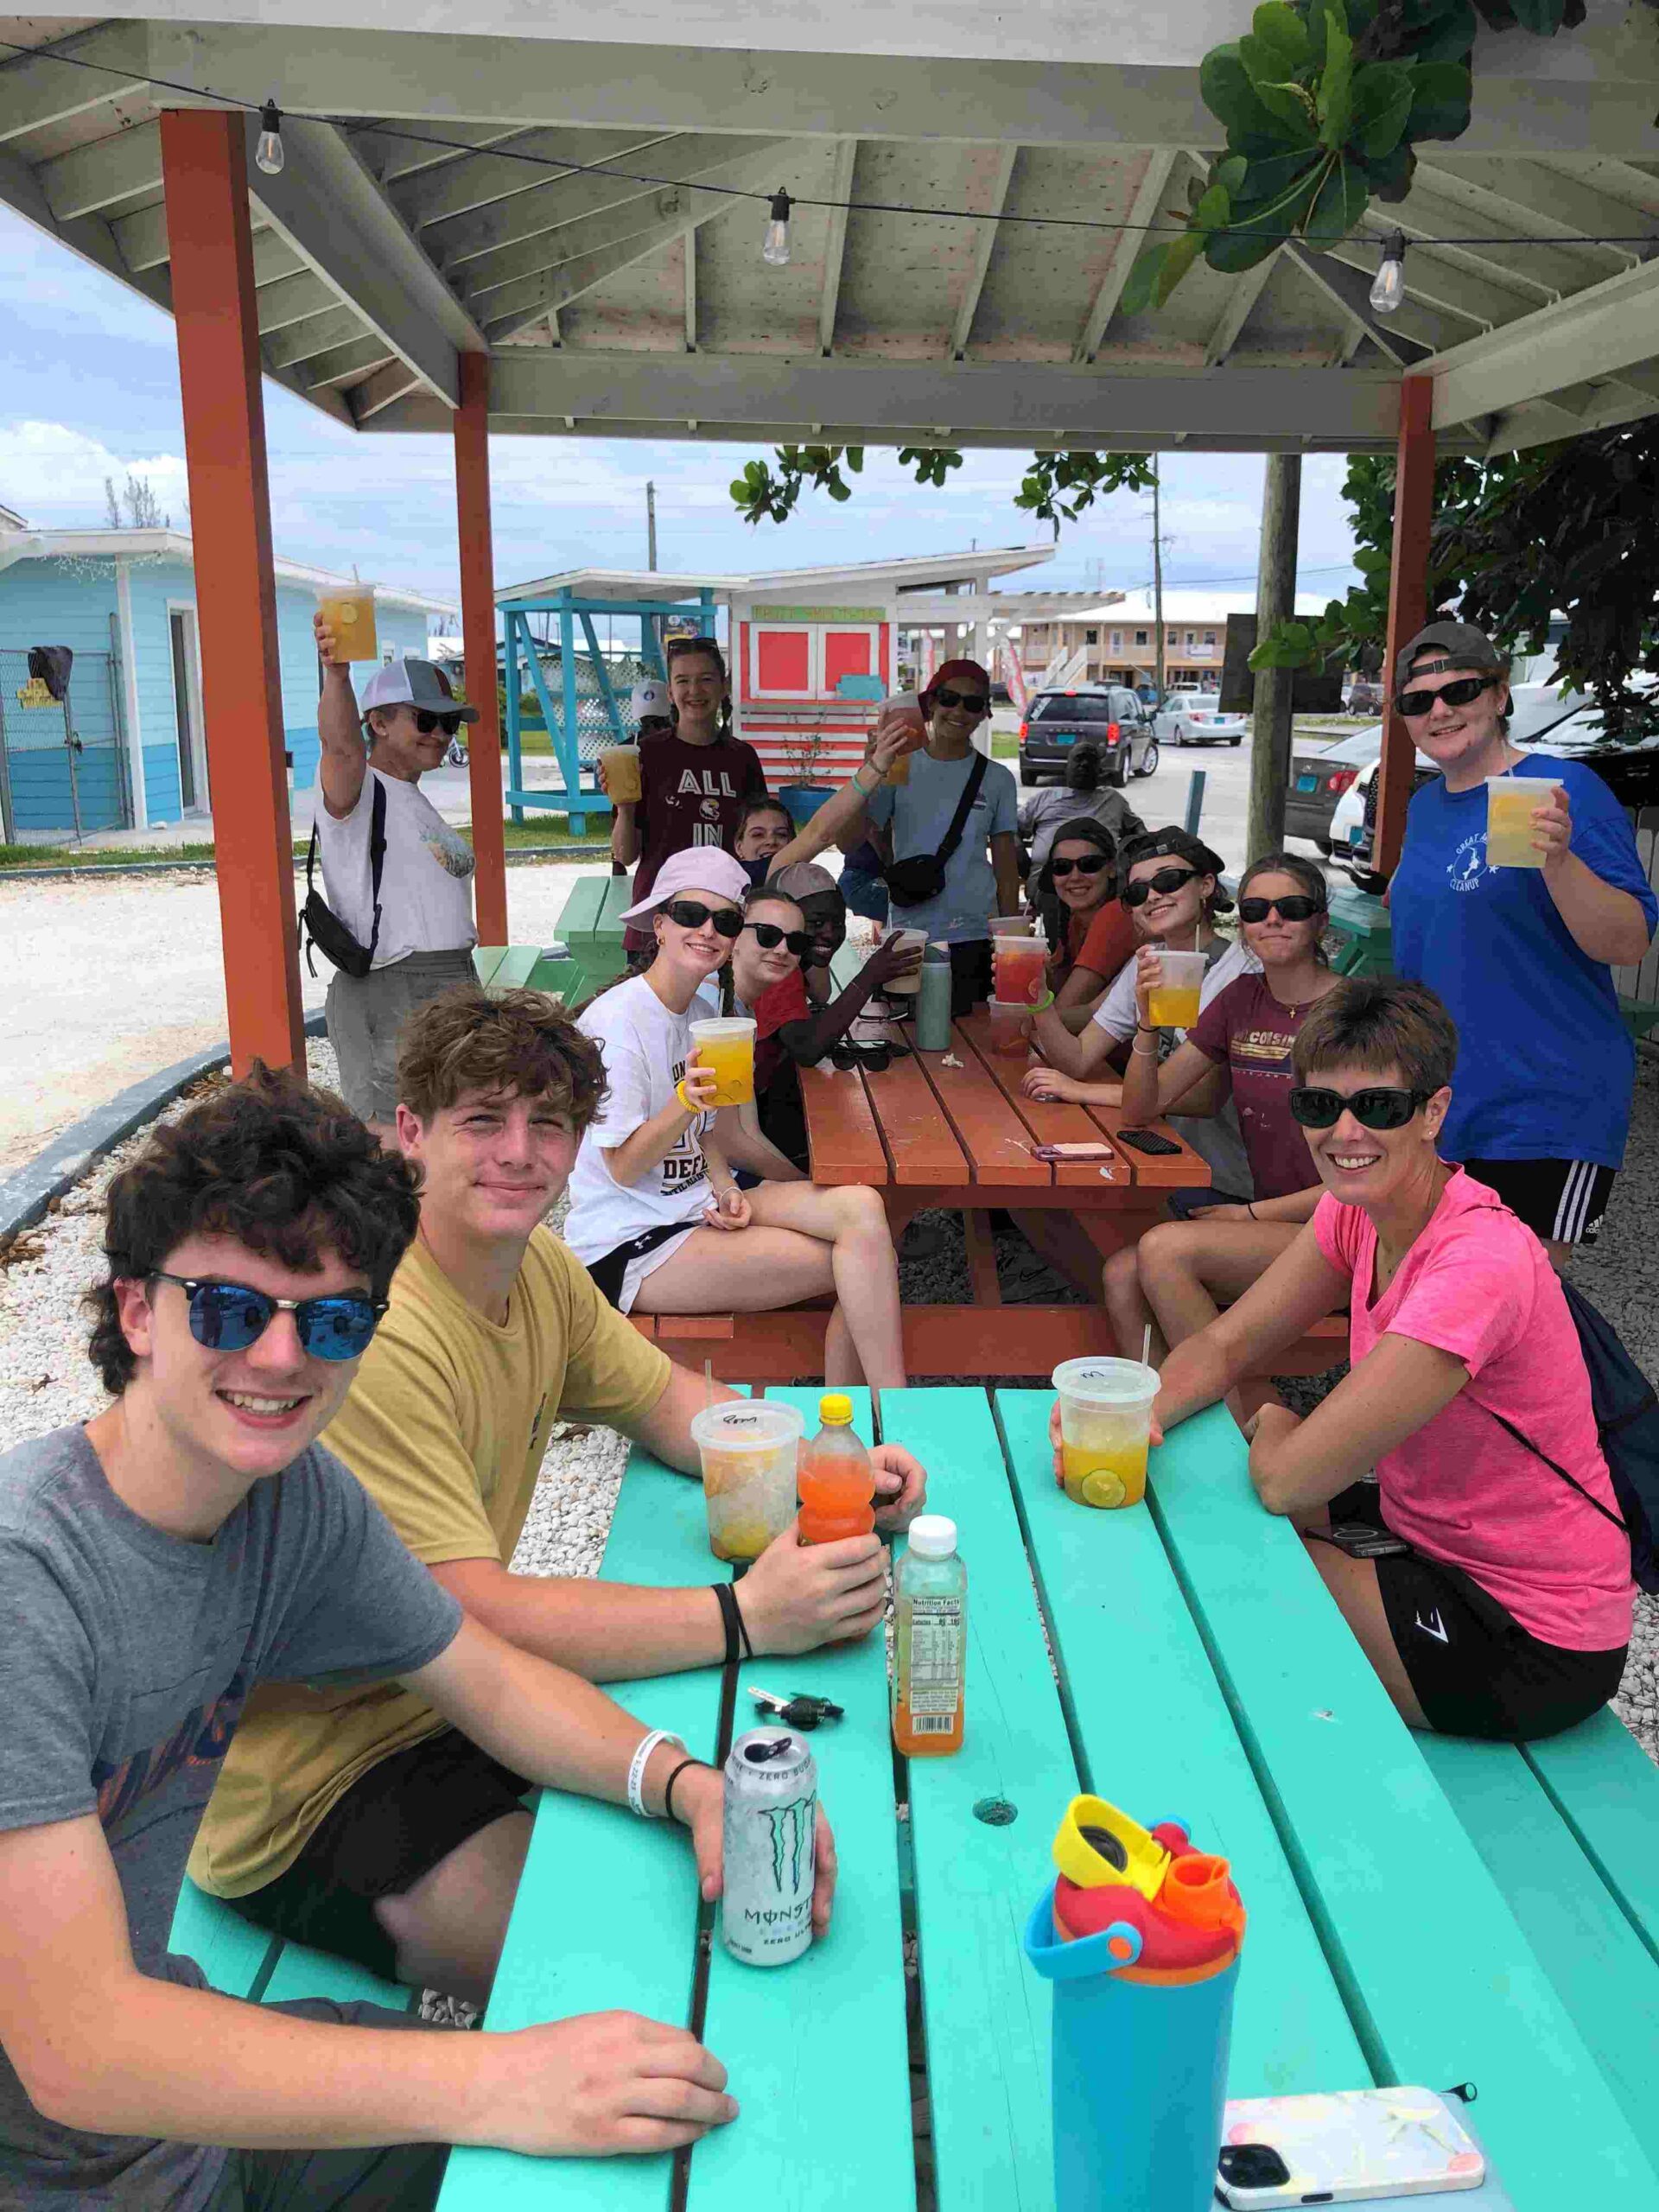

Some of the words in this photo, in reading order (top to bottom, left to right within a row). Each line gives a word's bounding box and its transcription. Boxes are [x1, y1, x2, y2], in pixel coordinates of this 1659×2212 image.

[677, 769, 736, 798] ALL
[693, 823, 723, 848] IN
[1456, 833, 1479, 855] GREAT
[1450, 877, 1479, 892] CLEANUP
[912, 1598, 942, 1606] Nutrition
[943, 1597, 960, 1605] Facts
[759, 1771, 789, 1781] ZERO
[764, 1936, 791, 1946] ZERO
